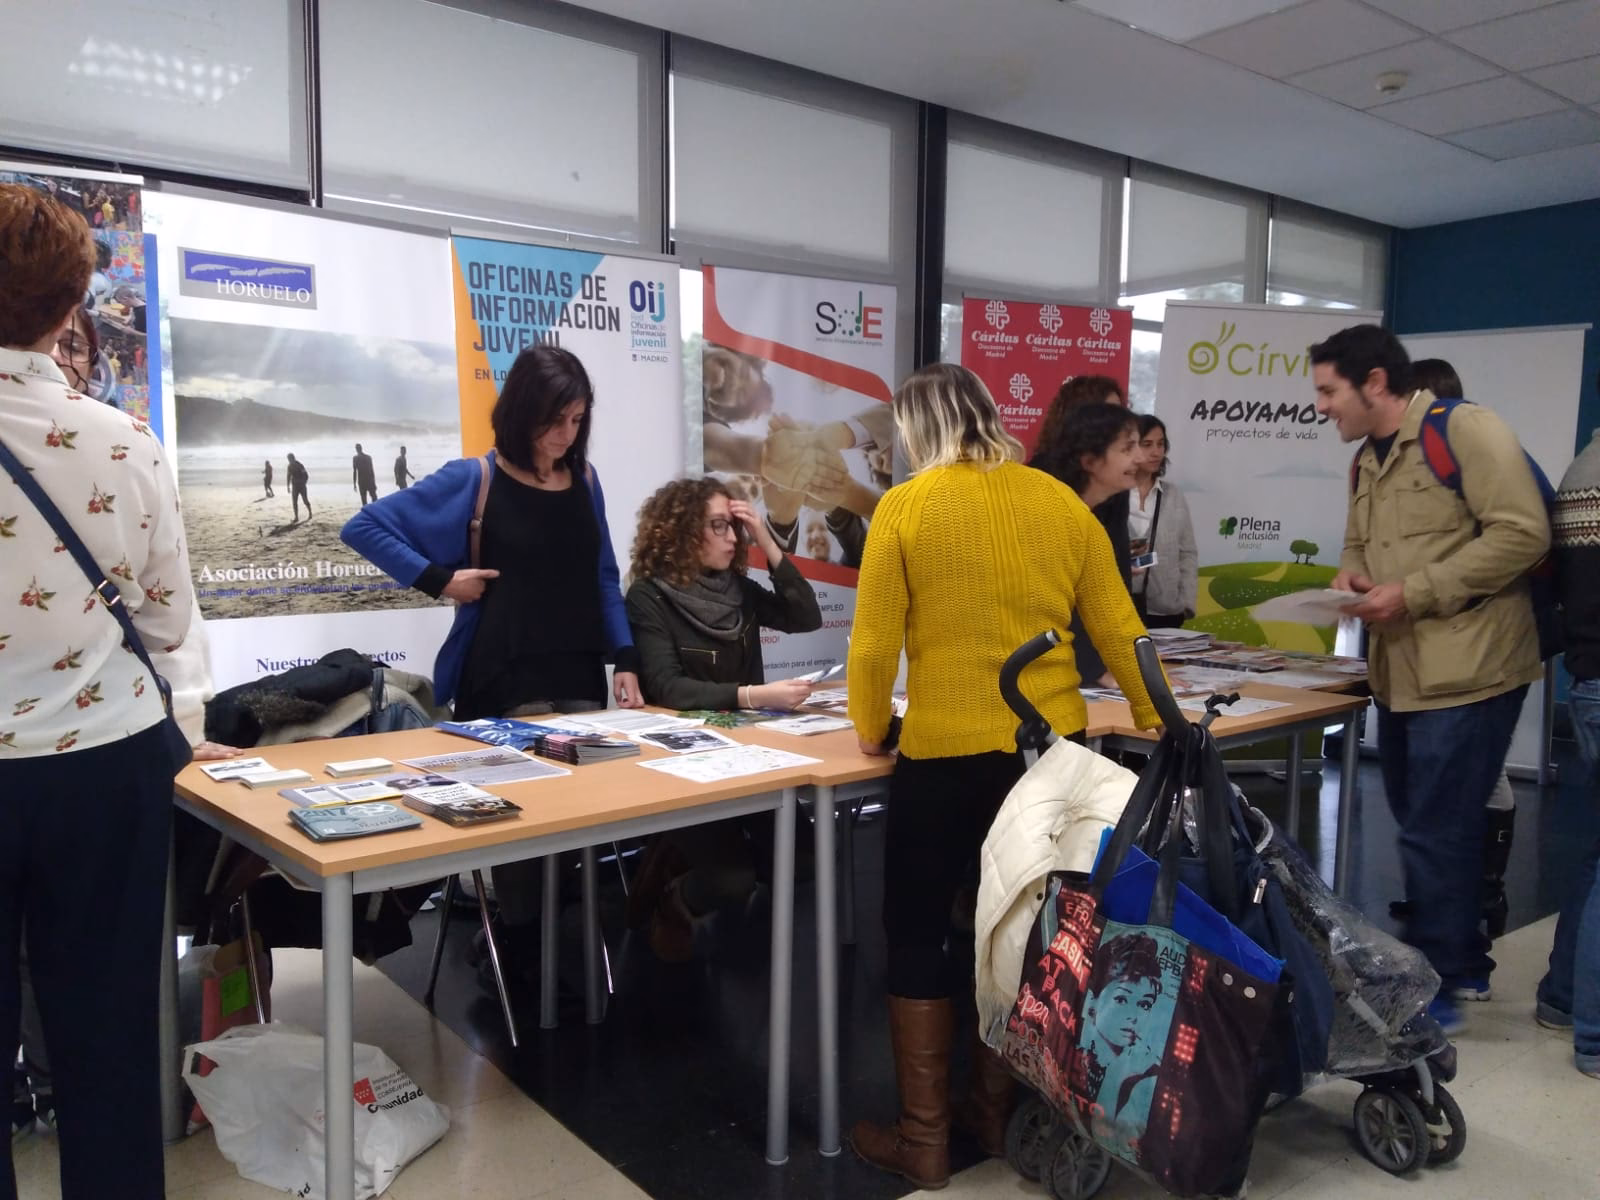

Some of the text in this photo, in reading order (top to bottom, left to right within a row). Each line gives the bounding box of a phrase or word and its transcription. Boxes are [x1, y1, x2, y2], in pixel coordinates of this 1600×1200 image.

[468, 261, 608, 302] OFICINAS DE
[216, 278, 311, 304] HORUELO
[631, 320, 658, 330] Oficinas
[631, 336, 667, 349] juvenil
[971, 330, 1020, 344] Cáritas
[1025, 334, 1072, 347] Cáritas
[1076, 337, 1122, 350] Cáritas
[641, 353, 669, 363] MADRID
[985, 350, 1006, 358] Madrid
[1039, 353, 1059, 361] Madrid
[1089, 356, 1109, 364] Madrid
[1227, 342, 1311, 377] Círvi
[474, 368, 508, 381] EN LO
[1206, 427, 1318, 443] proyectos de vida
[1240, 516, 1281, 532] Plena
[1238, 531, 1280, 541] inclusión
[199, 562, 309, 583] Asociación
[820, 603, 845, 612] MPLEO
